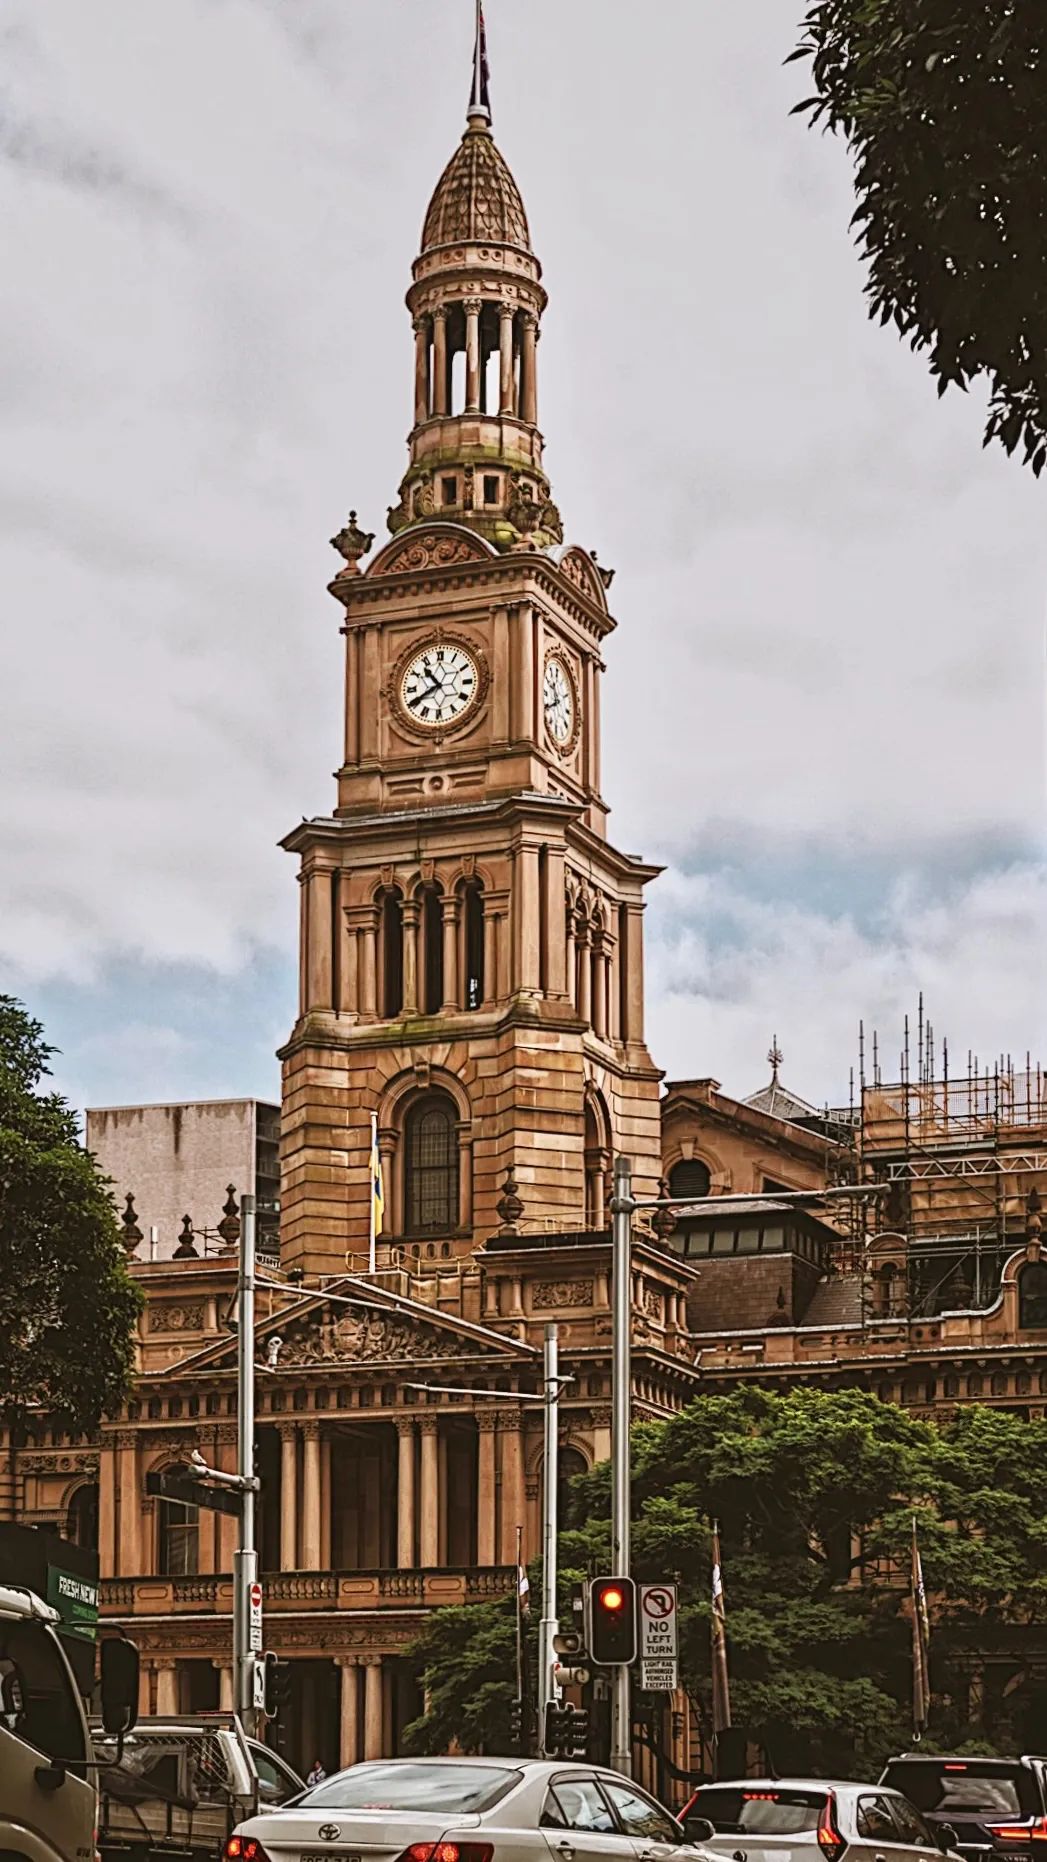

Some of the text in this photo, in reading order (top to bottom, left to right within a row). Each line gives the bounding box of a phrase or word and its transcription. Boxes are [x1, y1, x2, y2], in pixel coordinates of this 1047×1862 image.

[58, 1575, 80, 1601] FRESH
[80, 1583, 96, 1606] NEW
[648, 1621, 669, 1633] NO
[646, 1634, 671, 1644] LEFT
[646, 1645, 673, 1654] TURN
